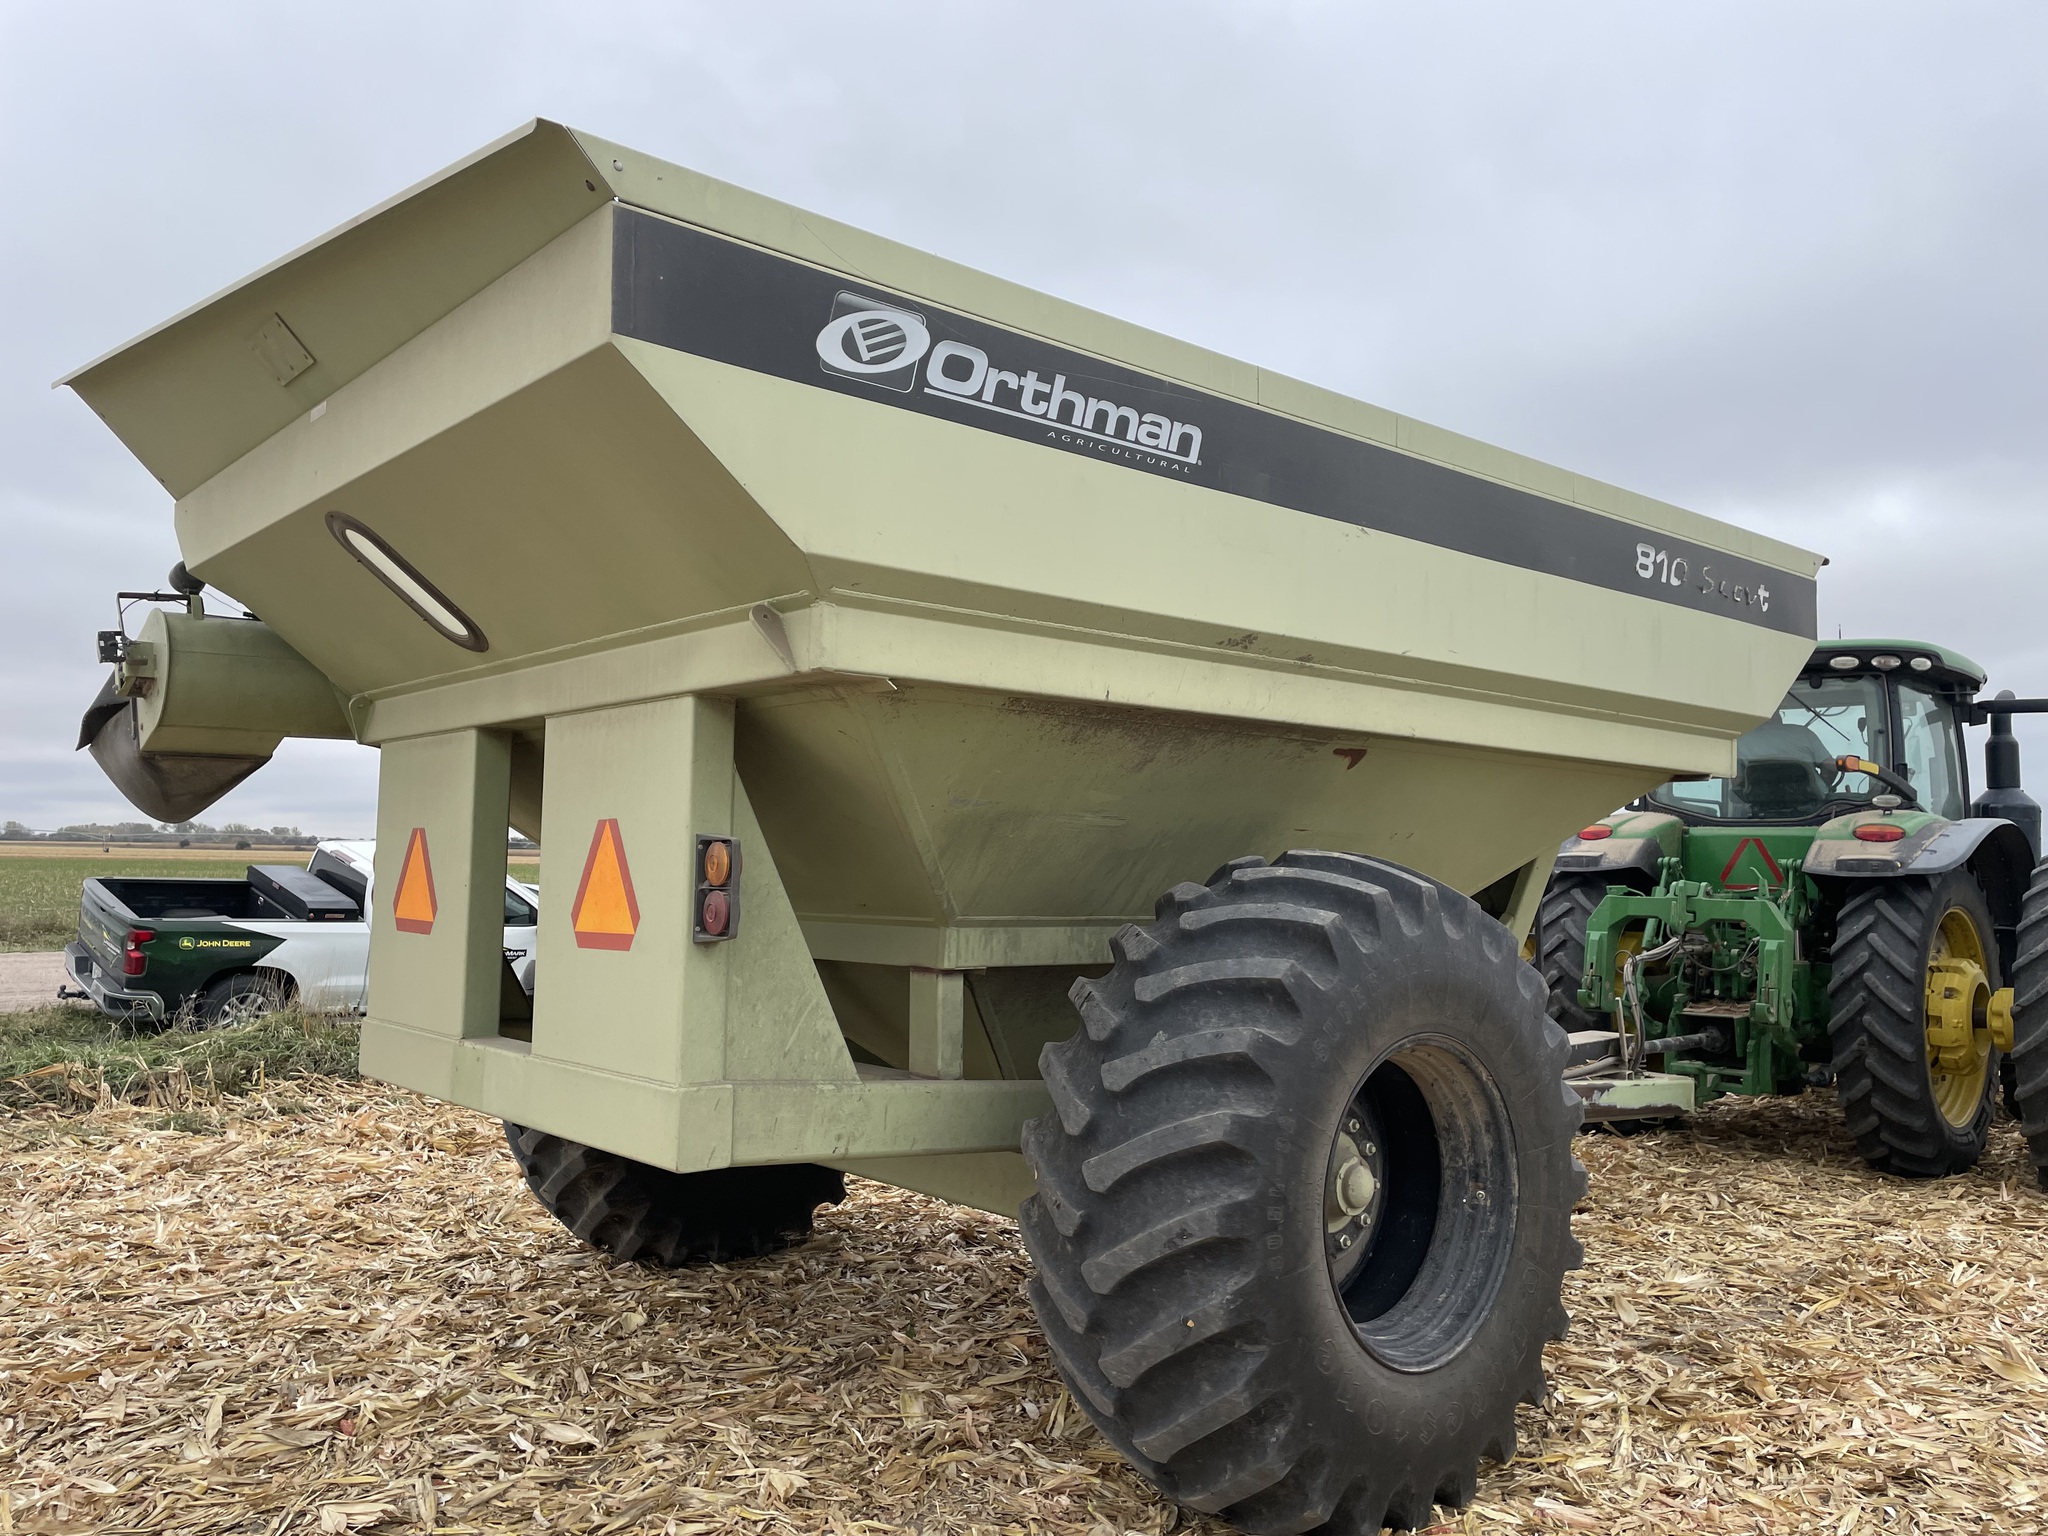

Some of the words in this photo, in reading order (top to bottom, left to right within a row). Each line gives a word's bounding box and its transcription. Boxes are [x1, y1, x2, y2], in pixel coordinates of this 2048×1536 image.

[926, 339, 1203, 462] Orthman
[1047, 430, 1191, 474] AGRICULTURAL
[1636, 542, 1688, 586] 810
[197, 939, 220, 947] JOHN
[222, 939, 251, 947] DEERE
